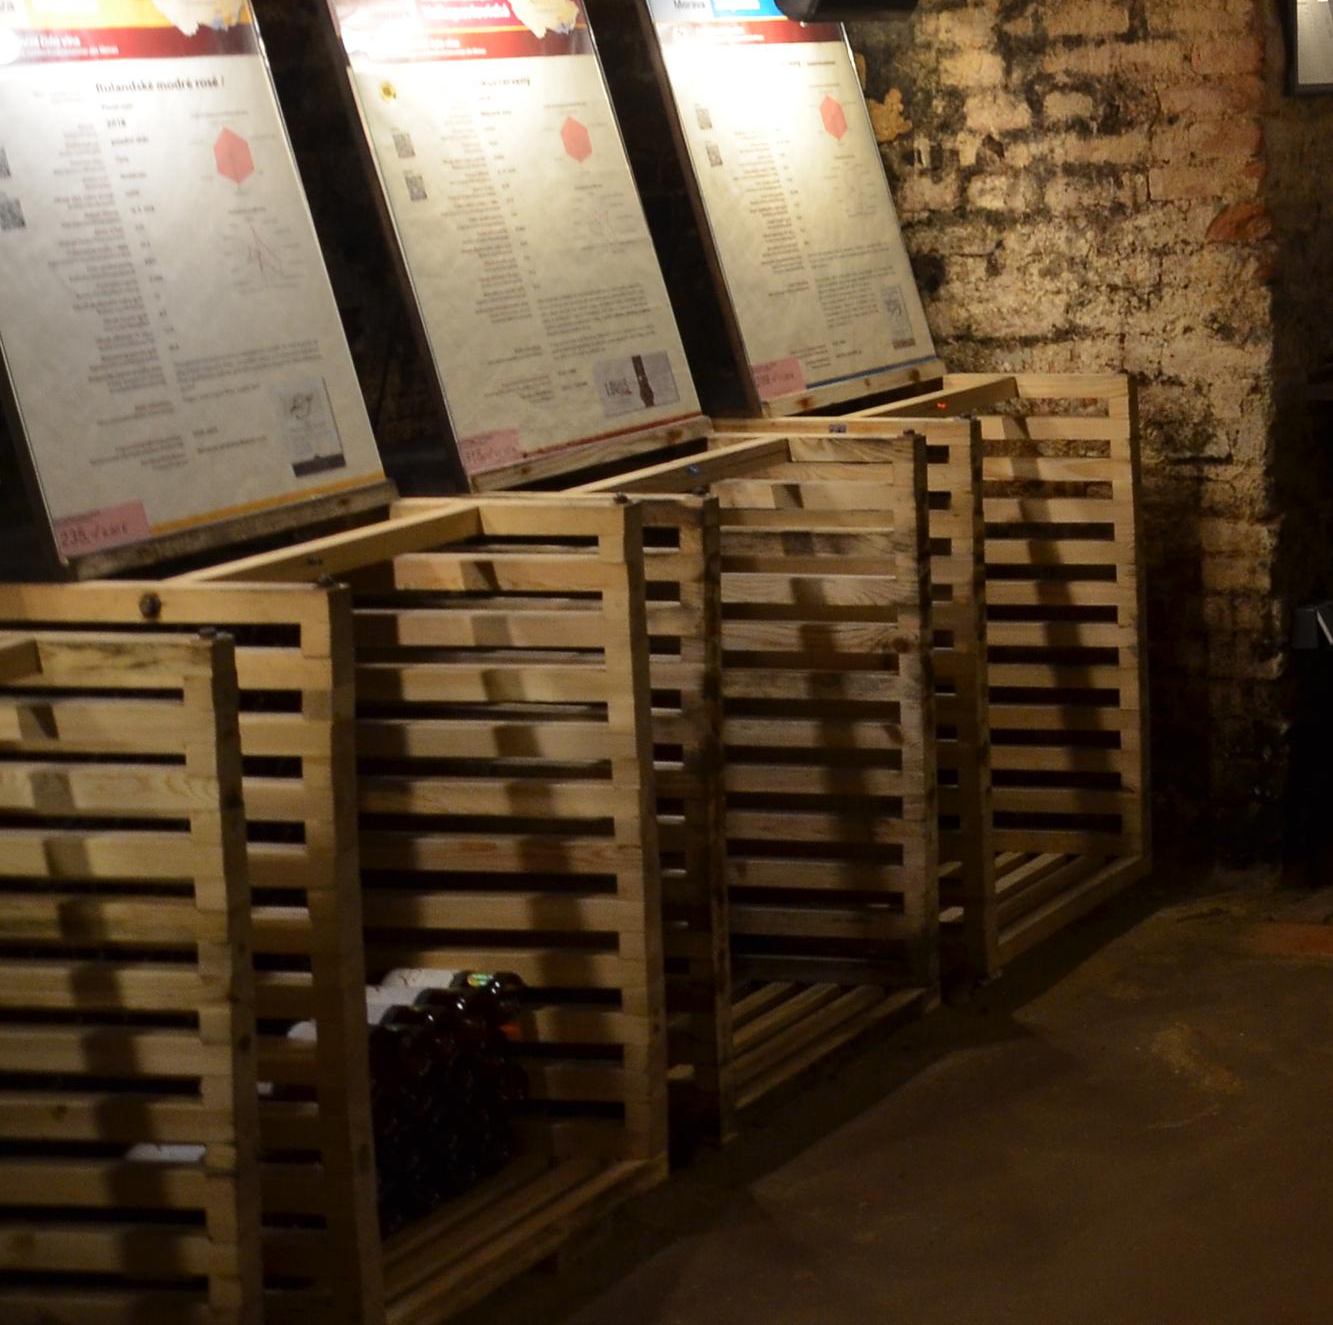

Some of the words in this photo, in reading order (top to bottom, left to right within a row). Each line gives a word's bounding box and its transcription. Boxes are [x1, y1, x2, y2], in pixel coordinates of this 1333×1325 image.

[95, 80, 154, 93] Rulandské
[156, 78, 192, 91] modré
[195, 75, 221, 89] rosé
